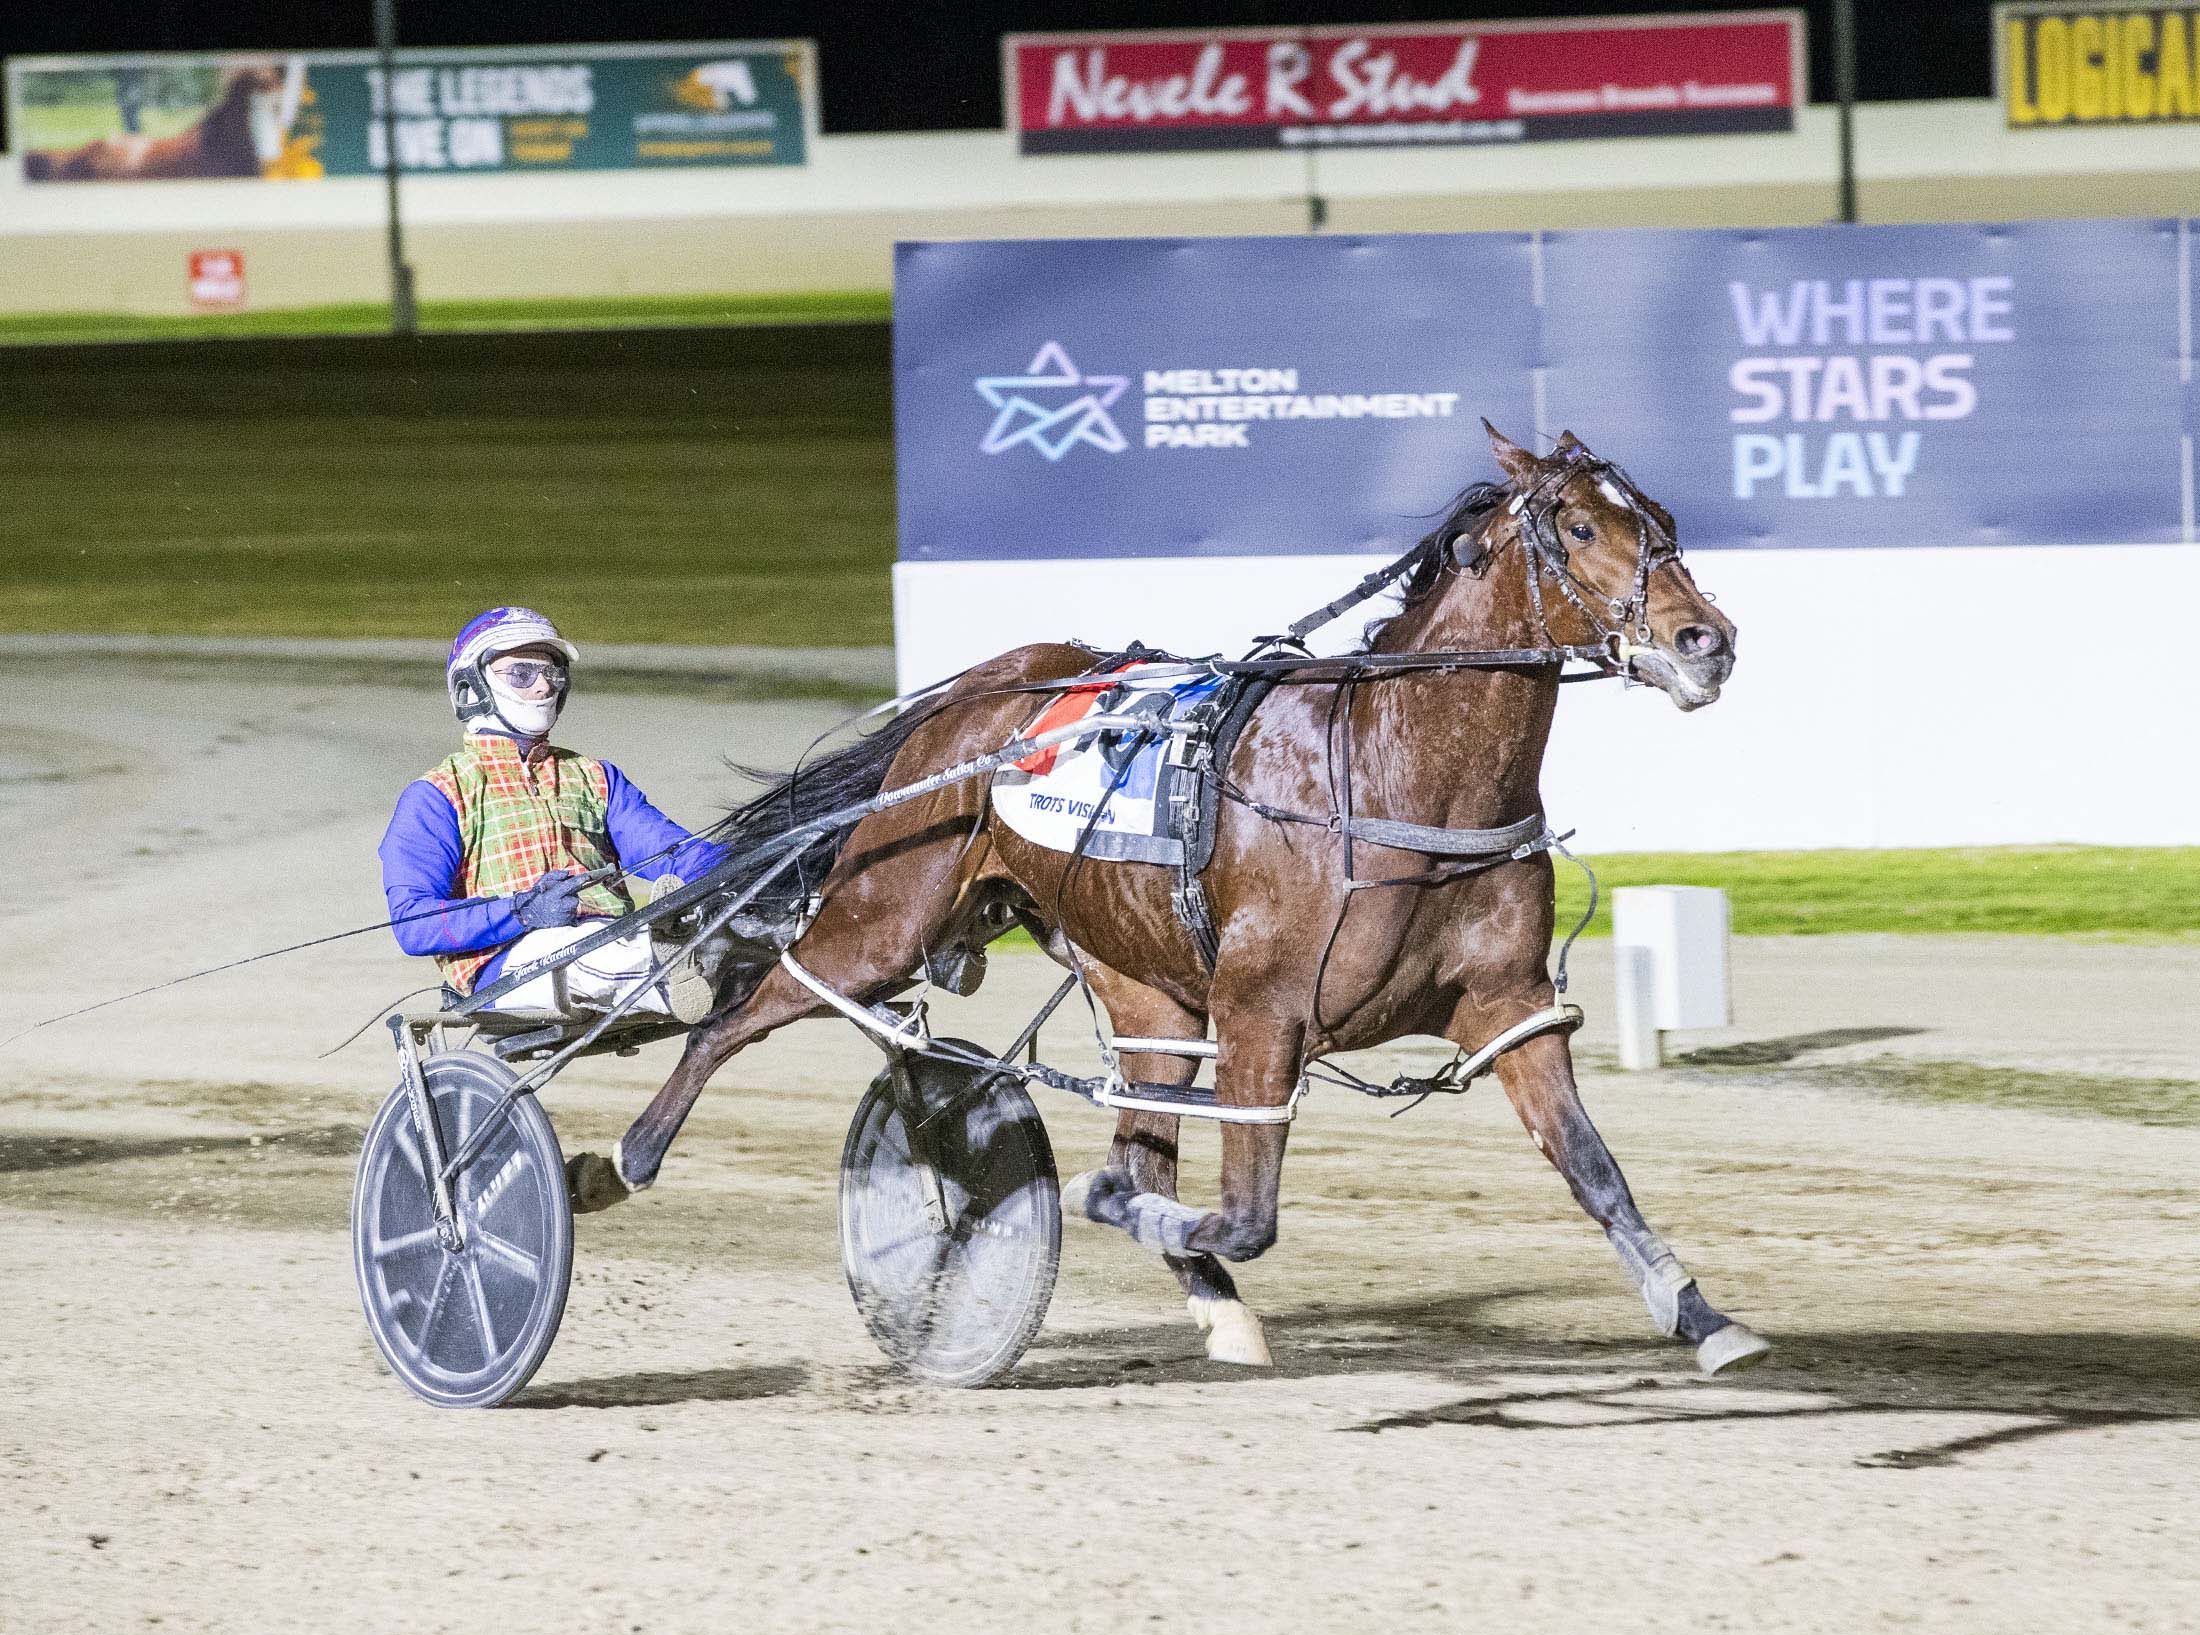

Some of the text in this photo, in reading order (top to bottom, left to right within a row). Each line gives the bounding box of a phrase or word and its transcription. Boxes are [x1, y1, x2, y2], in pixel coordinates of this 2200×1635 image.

[1049, 38, 1480, 125] Nevele R Stud
[2009, 14, 2200, 121] LOGICA
[1729, 276, 2015, 346] WHERE
[1144, 368, 1297, 395] MELTON
[1145, 392, 1458, 422] ENTERTAINMENT
[1729, 354, 1976, 424] STARS
[1145, 423, 1249, 449] PARK
[1733, 431, 1921, 499] PLAY
[1029, 793, 1066, 813] TROTS
